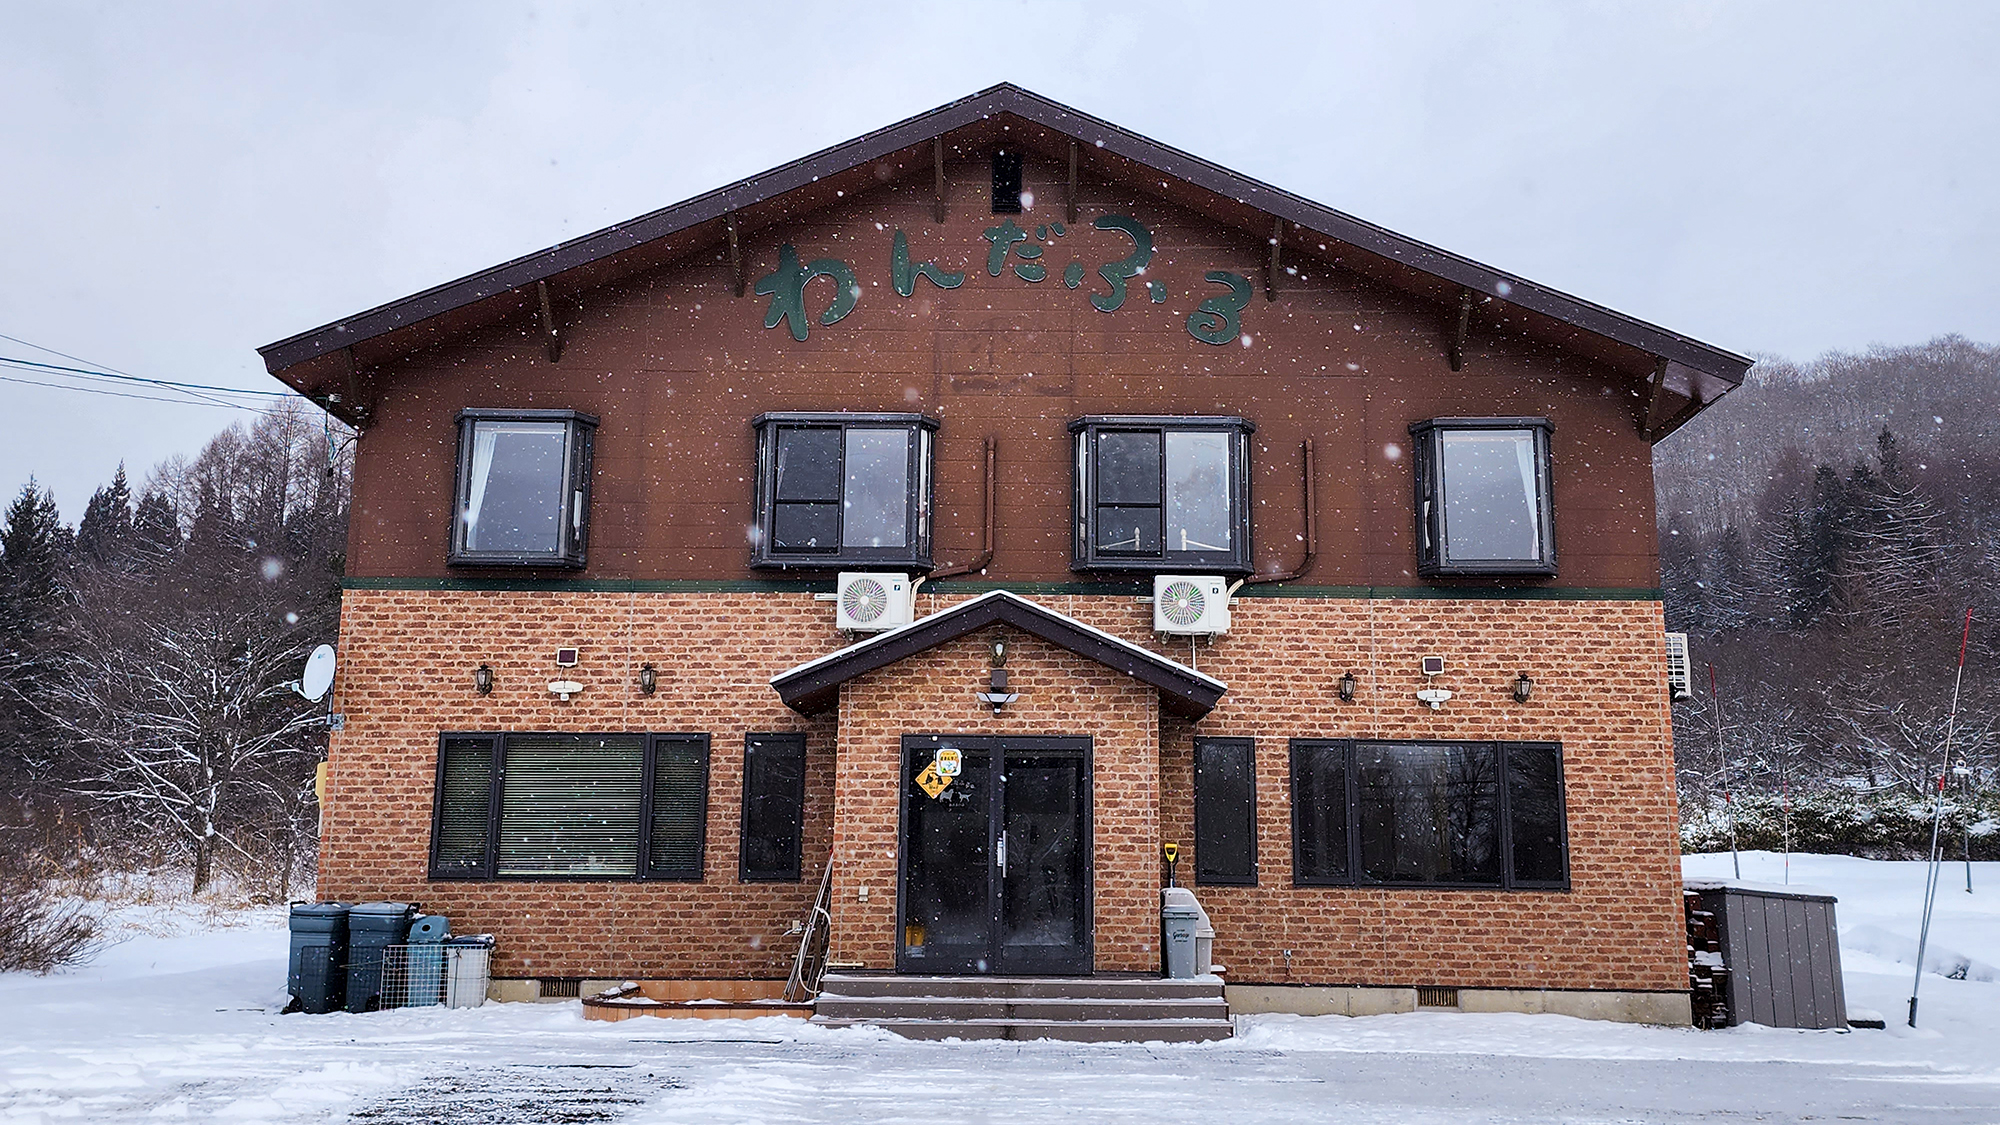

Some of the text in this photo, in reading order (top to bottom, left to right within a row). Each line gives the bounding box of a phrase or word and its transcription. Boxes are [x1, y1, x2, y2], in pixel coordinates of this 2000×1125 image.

[754, 213, 1253, 345] わんだふる
